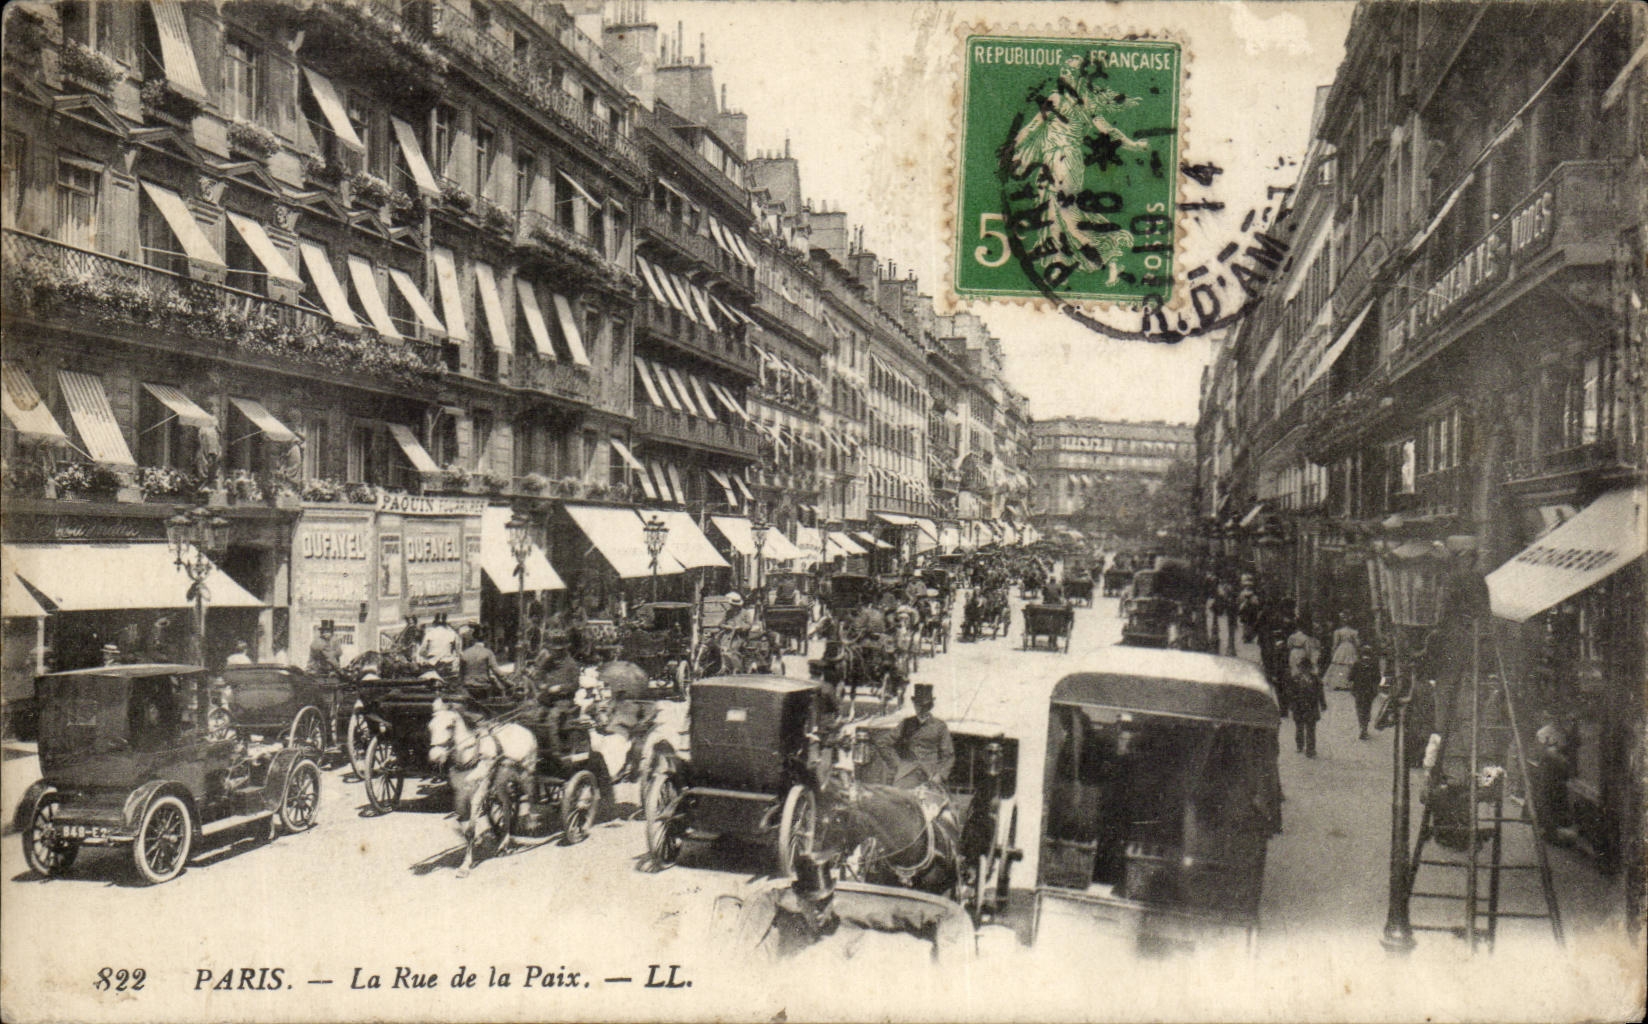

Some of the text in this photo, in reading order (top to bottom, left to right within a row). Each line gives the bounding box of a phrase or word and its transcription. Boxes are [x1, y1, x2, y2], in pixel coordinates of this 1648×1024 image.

[1089, 50, 1171, 71] FRANÇAISE
[1178, 161, 1225, 212] 14
[974, 212, 1012, 268] 5
[381, 494, 435, 512] PAQUIN
[302, 532, 367, 560] DUFAYEL
[406, 537, 460, 562] DUFAYEL
